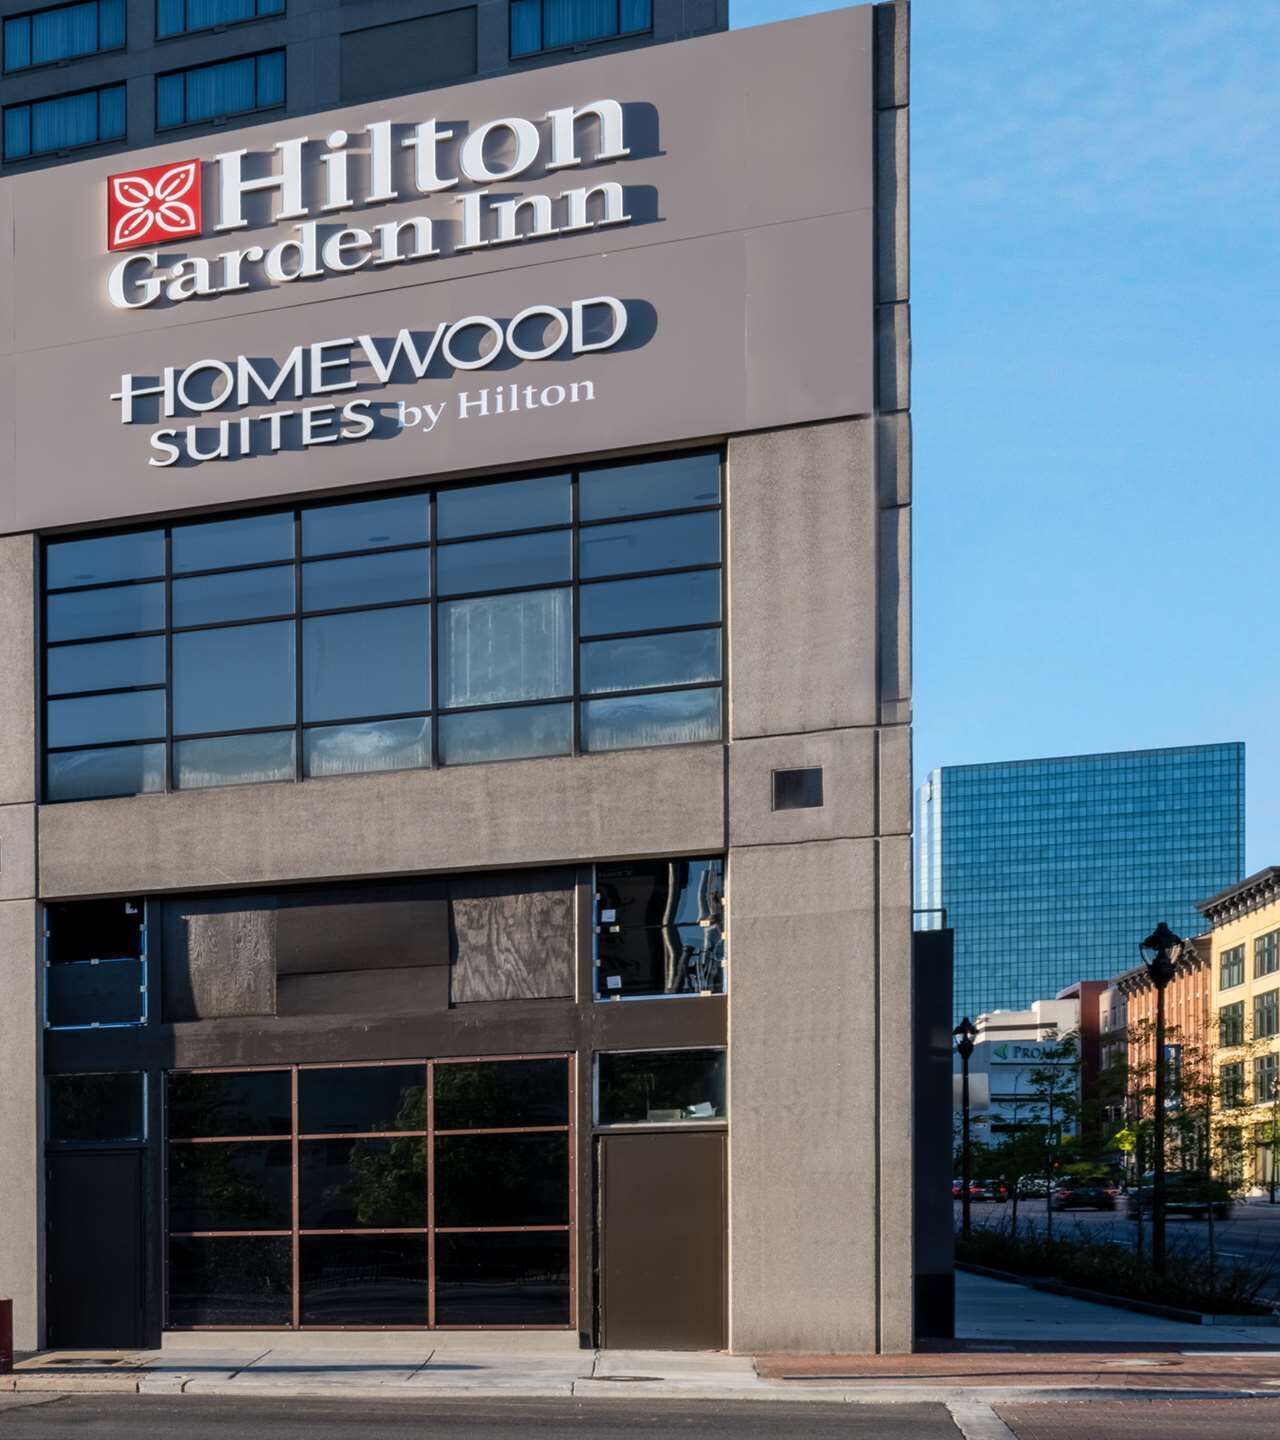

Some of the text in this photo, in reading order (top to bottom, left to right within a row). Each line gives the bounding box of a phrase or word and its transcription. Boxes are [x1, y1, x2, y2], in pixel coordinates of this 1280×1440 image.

[213, 98, 631, 232] Hilton
[106, 181, 632, 309] Garden Inn
[110, 295, 629, 424] HOMEWOOD
[148, 379, 596, 467] SUITES by Hilton
